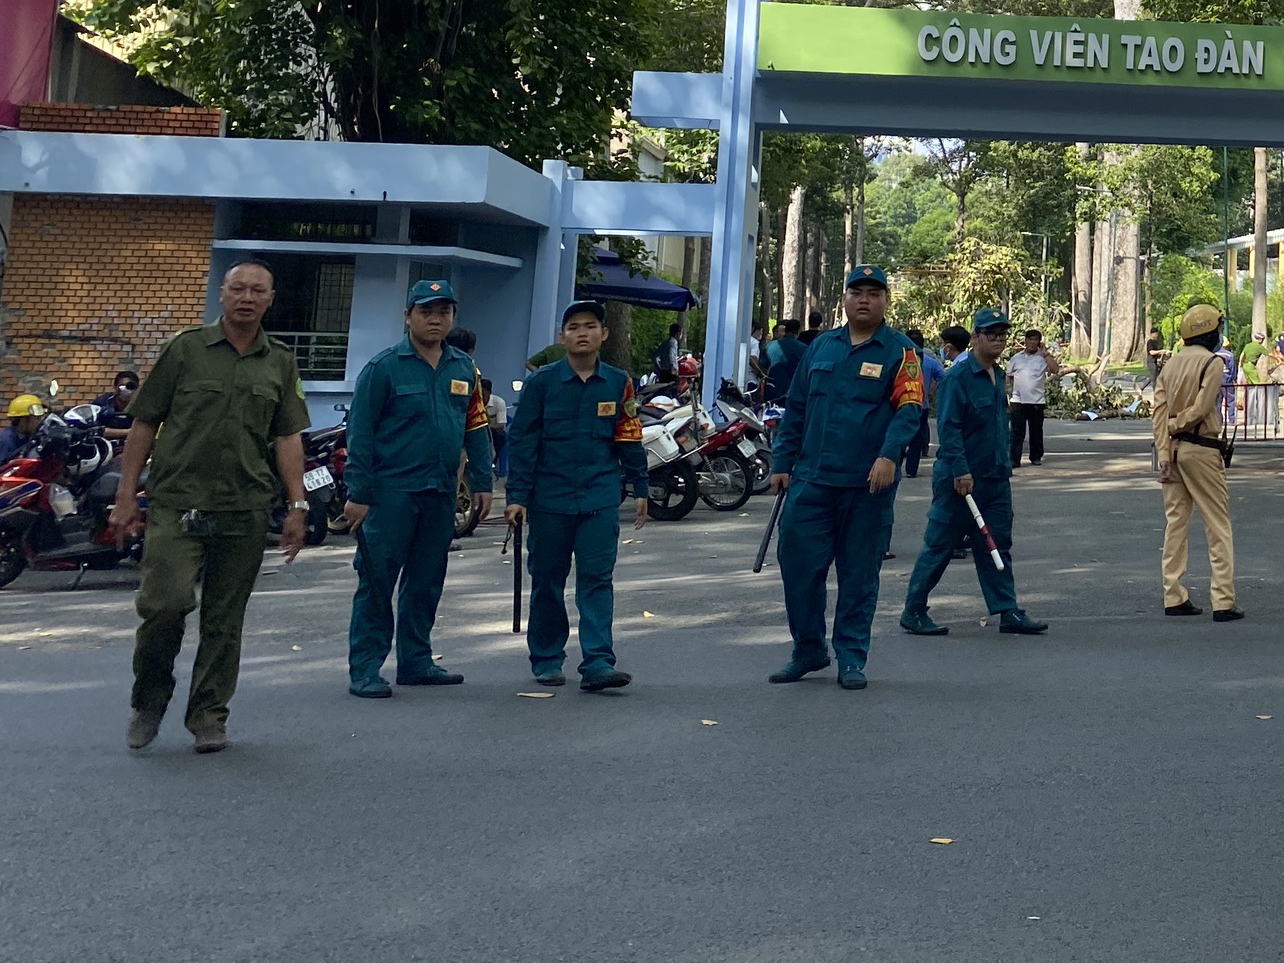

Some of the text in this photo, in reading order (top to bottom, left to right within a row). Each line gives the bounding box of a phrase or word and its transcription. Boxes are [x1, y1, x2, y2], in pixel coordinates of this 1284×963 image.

[918, 17, 1264, 76] CÔNG VIÊN TAO ĐÀN
